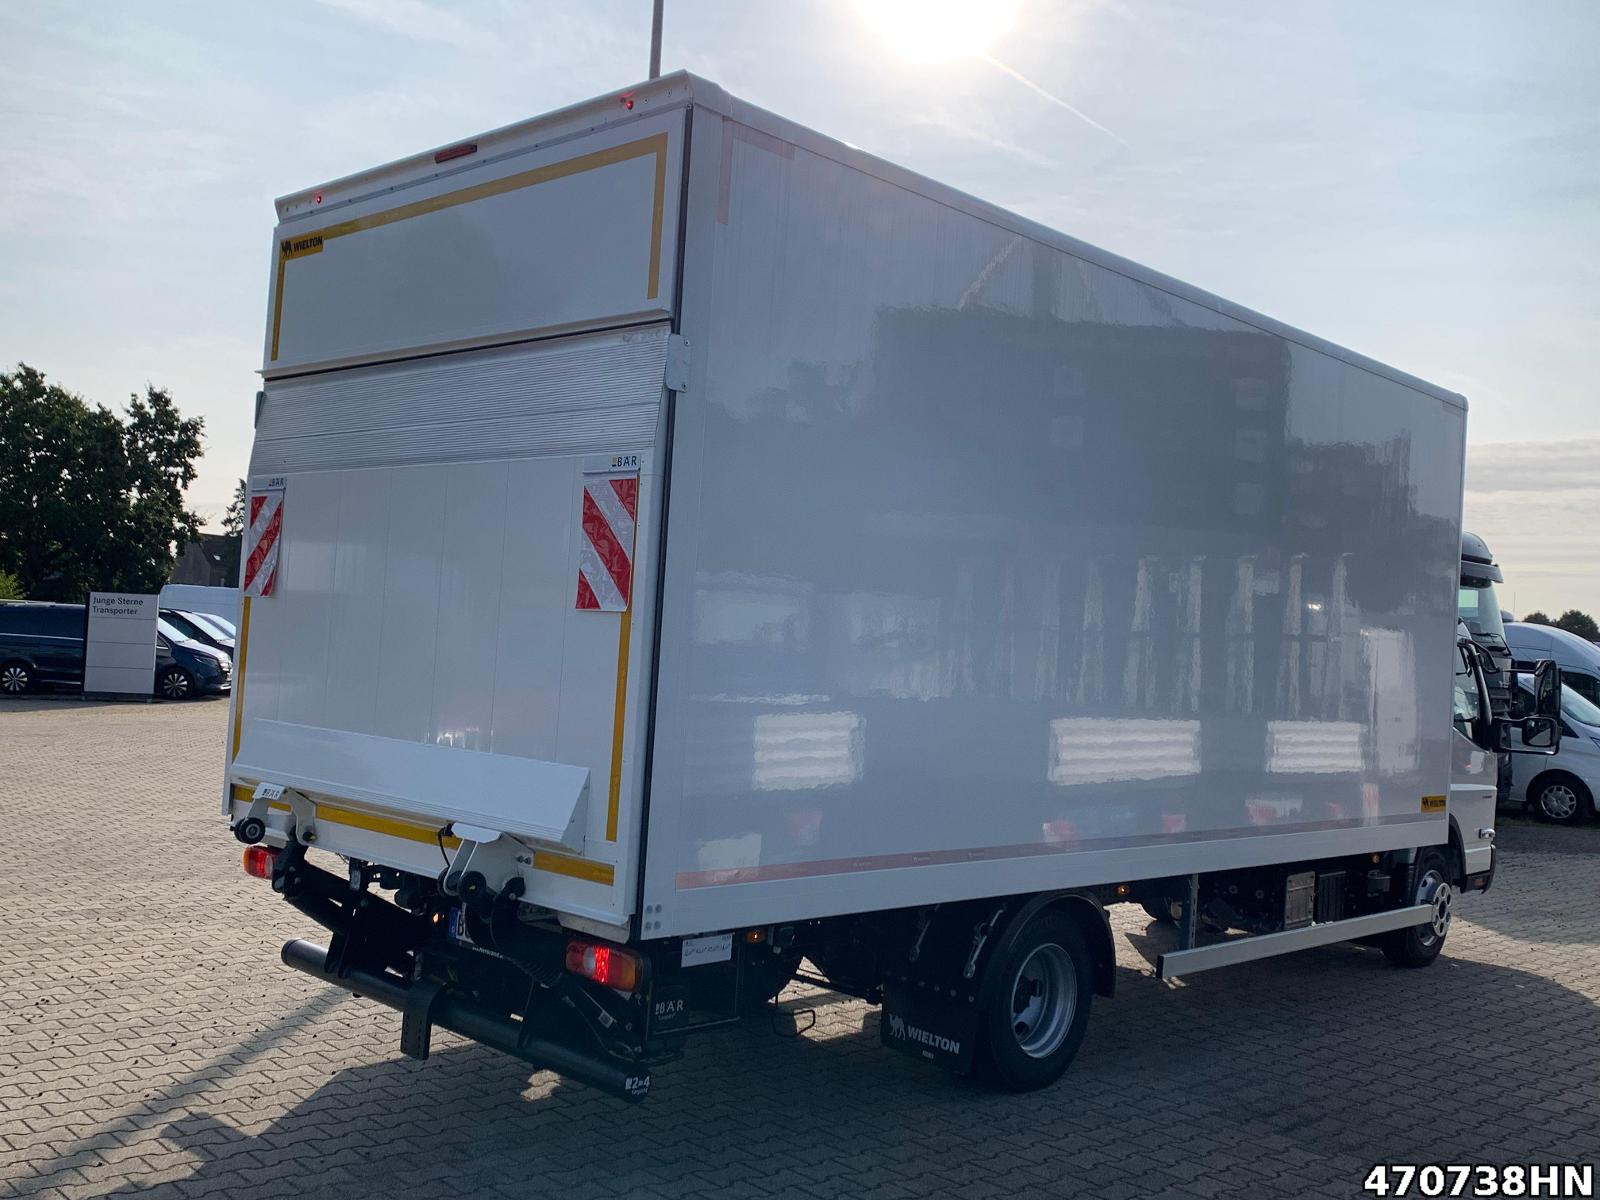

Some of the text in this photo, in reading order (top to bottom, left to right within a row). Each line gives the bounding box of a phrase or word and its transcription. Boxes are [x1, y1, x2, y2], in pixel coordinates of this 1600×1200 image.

[293, 236, 323, 252] WIELTON
[617, 456, 637, 467] BÄR
[93, 597, 144, 606] Junge Sterne
[92, 606, 138, 615] Transporter
[907, 1024, 960, 1055] WIELTON
